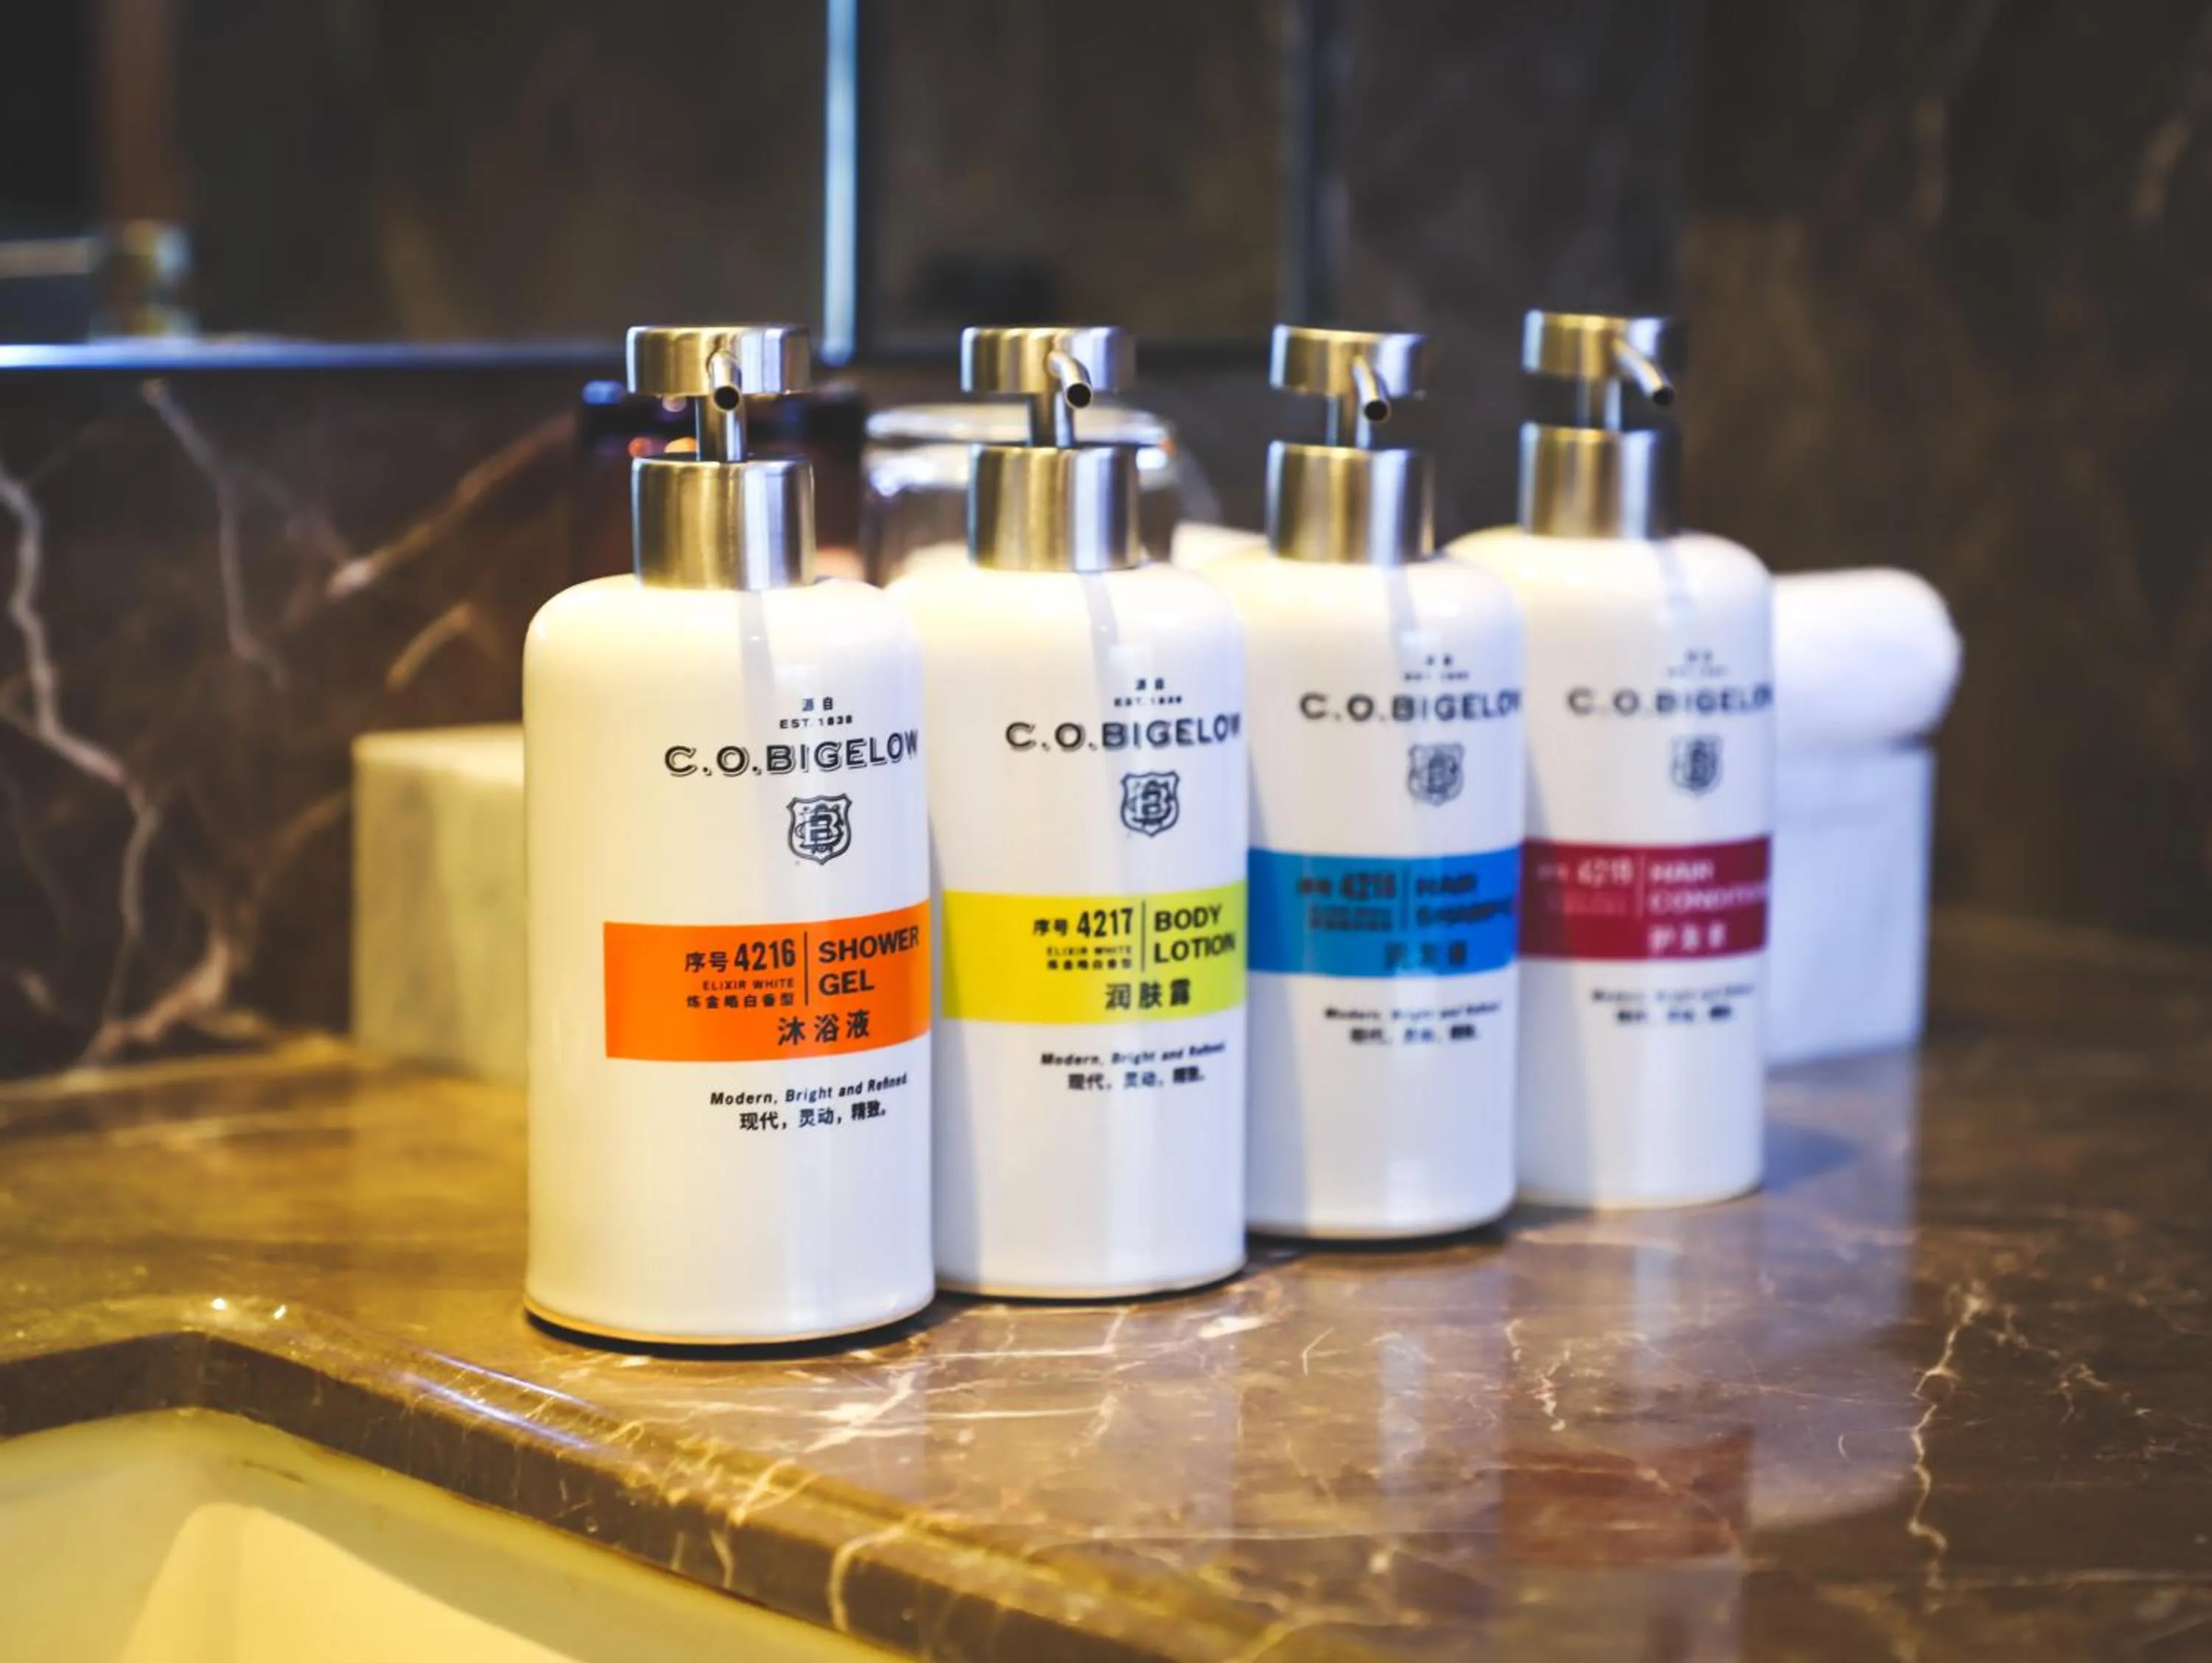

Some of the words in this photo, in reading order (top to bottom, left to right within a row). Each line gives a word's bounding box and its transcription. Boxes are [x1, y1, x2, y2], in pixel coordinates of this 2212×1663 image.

[664, 729, 919, 776] C.O.BIGELOW
[1077, 907, 1133, 937] 4217
[1154, 904, 1222, 932] BODY
[684, 951, 728, 973] 序号
[734, 938, 796, 972] 4216
[818, 926, 919, 963] SHOWER
[1154, 932, 1237, 963] LOTION
[703, 980, 746, 991] ELIXIR
[753, 977, 794, 989] WHITE
[818, 970, 875, 996] GEL
[778, 1008, 870, 1045] 沐浴液
[785, 1087, 833, 1104] Bright
[838, 1081, 863, 1098] and
